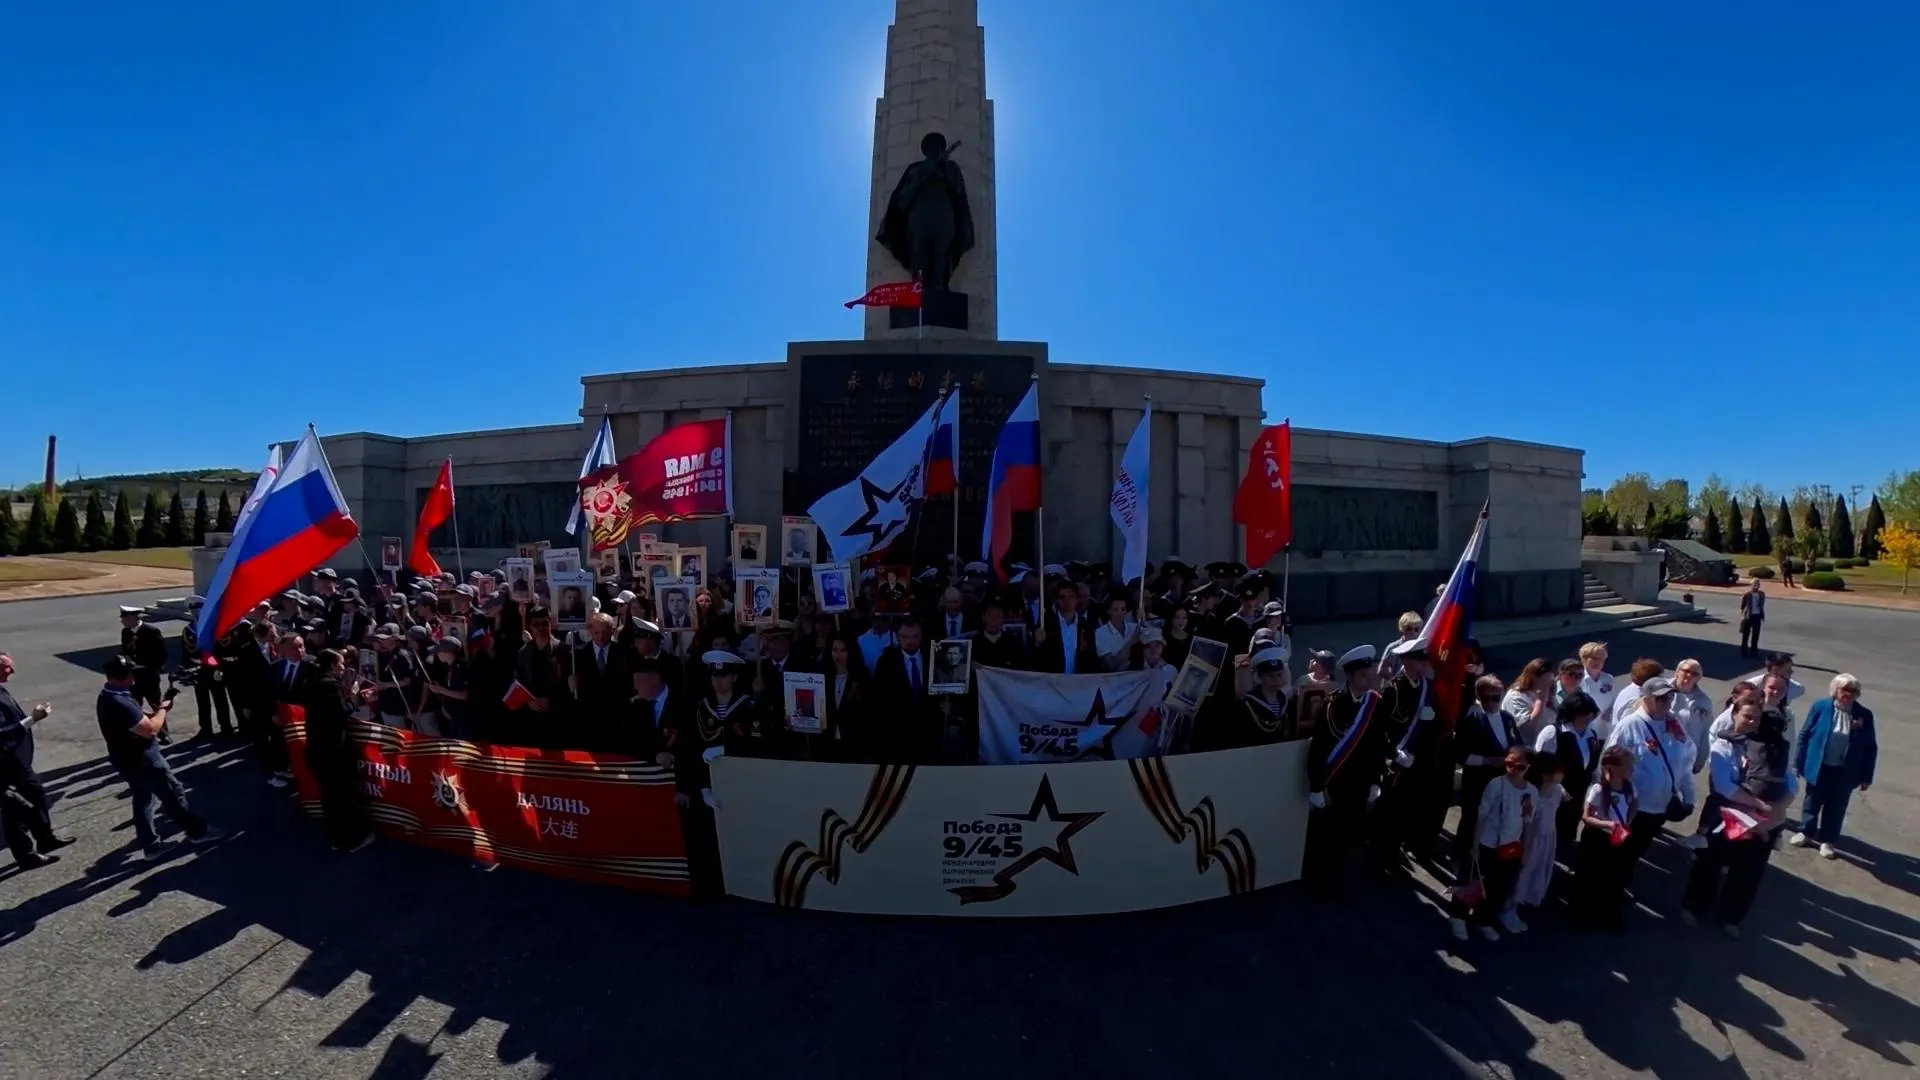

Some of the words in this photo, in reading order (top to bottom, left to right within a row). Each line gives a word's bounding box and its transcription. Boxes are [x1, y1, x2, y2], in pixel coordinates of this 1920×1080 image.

[1019, 722, 1079, 737] Победа
[1018, 734, 1080, 756] 9/45
[356, 758, 412, 785] РТНЫЙ
[516, 791, 592, 816] ДАЛЯНЬ
[540, 816, 579, 839] 大连
[943, 820, 1023, 835] Победа
[943, 835, 1024, 858] 9/45
